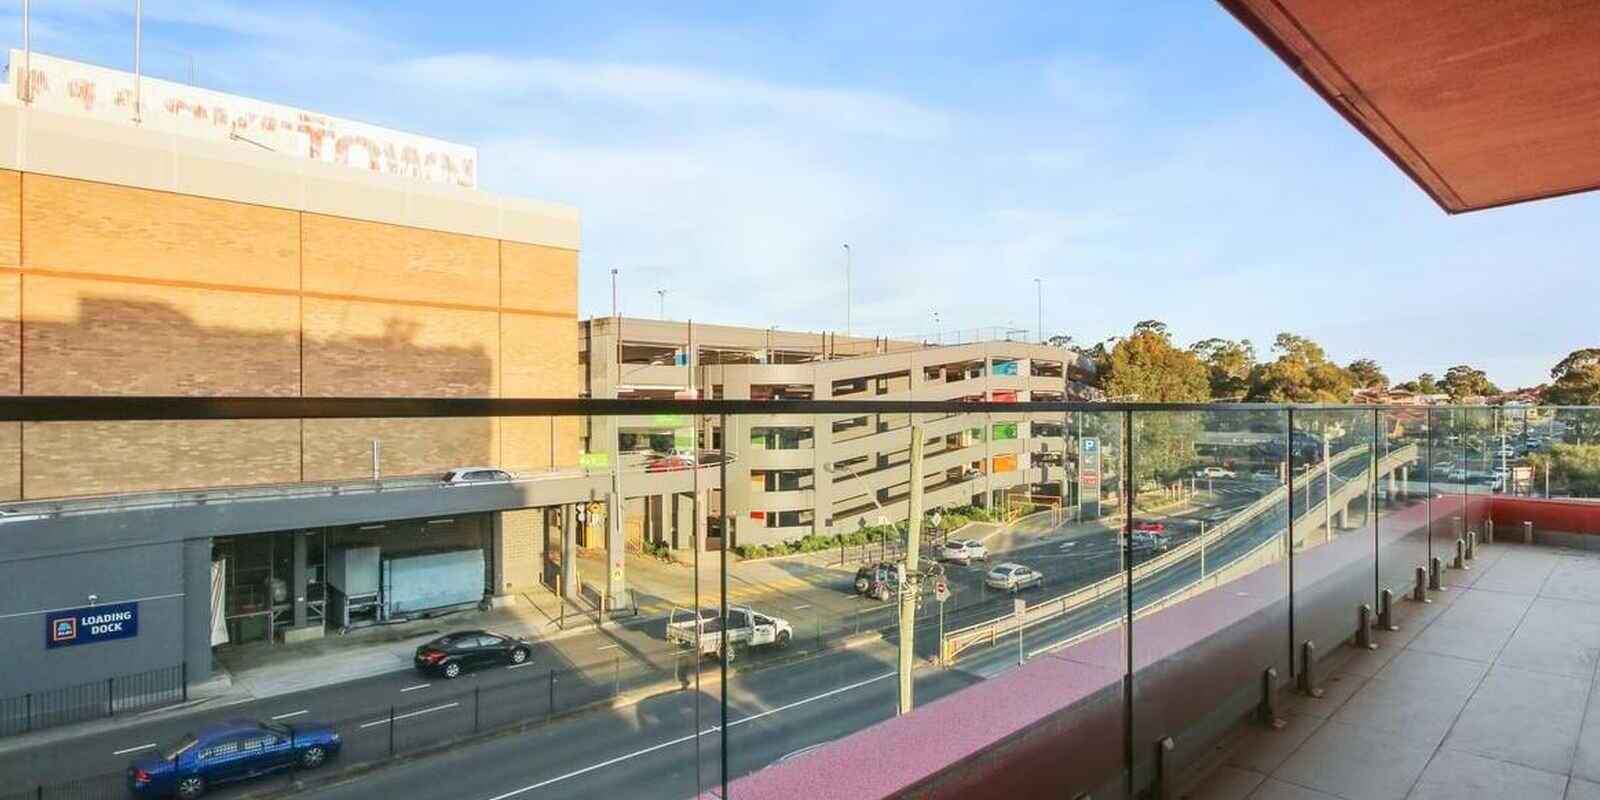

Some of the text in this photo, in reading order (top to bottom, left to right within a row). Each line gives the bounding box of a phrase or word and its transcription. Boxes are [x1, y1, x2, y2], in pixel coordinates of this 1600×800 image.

[1085, 440, 1095, 451] P
[81, 611, 132, 626] LOADING
[91, 622, 123, 635] DOCK
